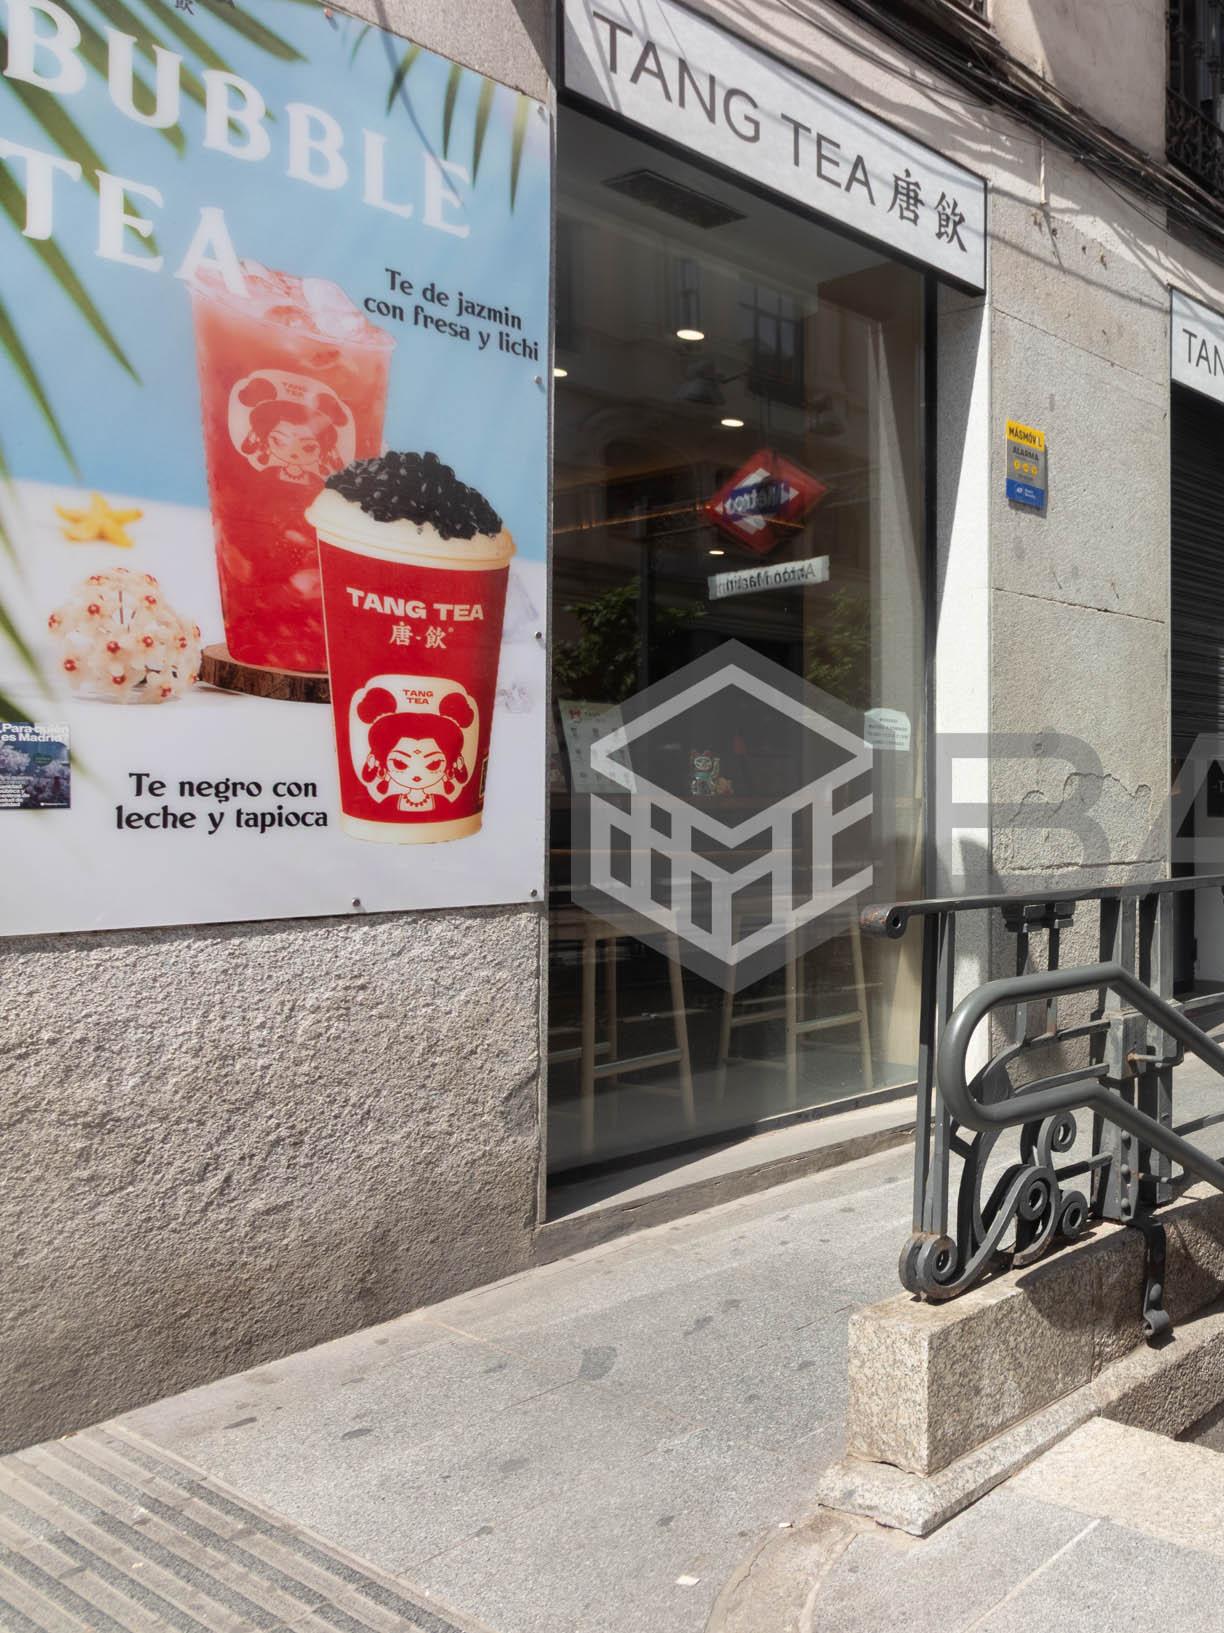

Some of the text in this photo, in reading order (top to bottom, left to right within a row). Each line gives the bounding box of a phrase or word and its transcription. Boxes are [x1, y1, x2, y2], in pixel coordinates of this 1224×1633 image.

[2, 0, 471, 239] BUBBLE
[592, 11, 876, 207] TANG TEA
[0, 137, 251, 299] TEA
[364, 297, 539, 361] con fresa y lichi
[385, 268, 522, 330] Te de jazmin
[345, 586, 485, 621] TANG TEA
[403, 689, 433, 697] TANG
[129, 772, 318, 804] Te negro con
[116, 804, 329, 835] leche y tapioca
